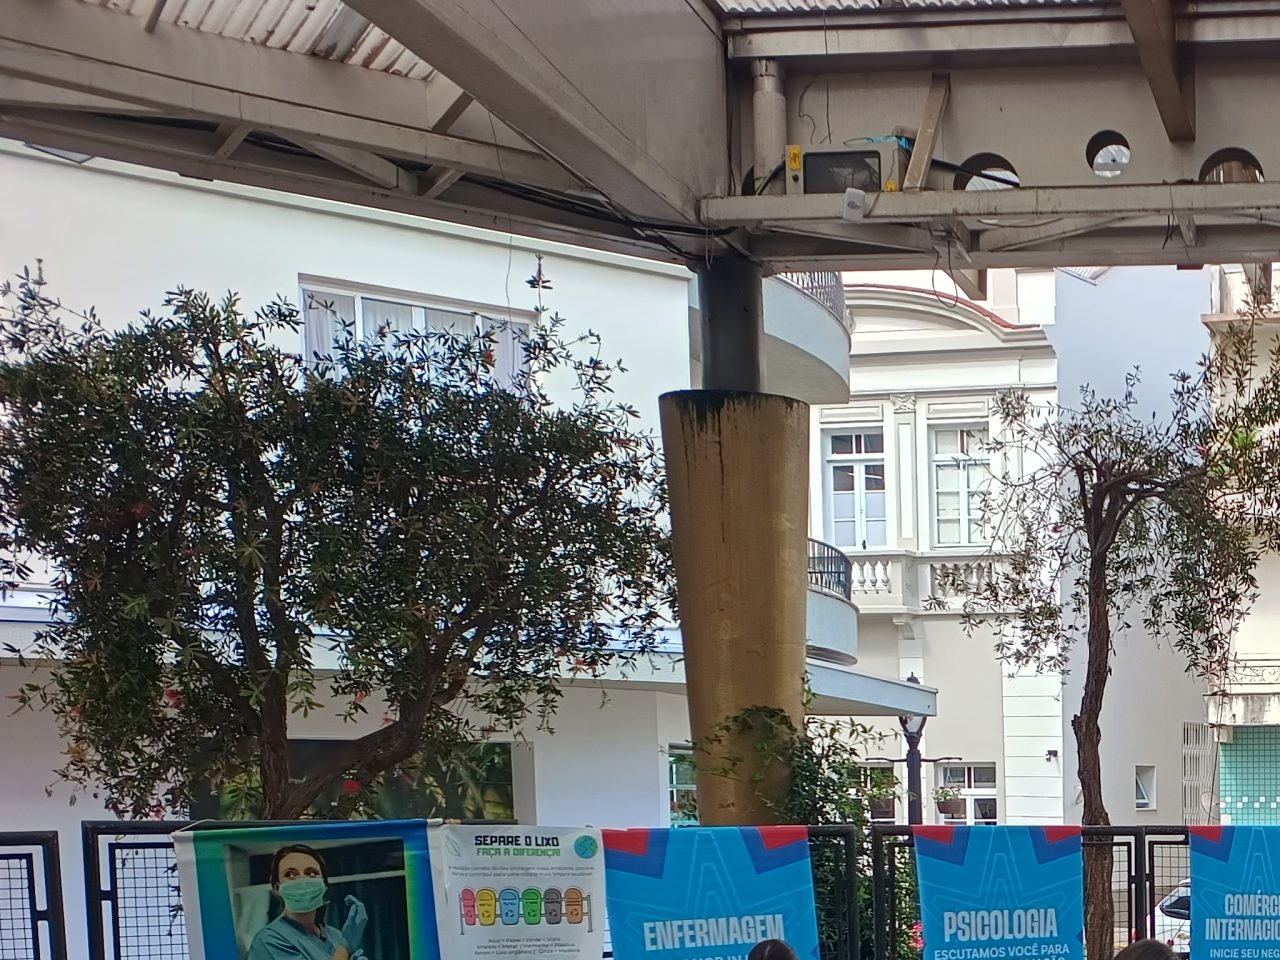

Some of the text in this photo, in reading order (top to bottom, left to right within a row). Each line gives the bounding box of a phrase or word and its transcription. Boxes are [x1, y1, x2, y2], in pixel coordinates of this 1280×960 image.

[475, 835, 559, 847] SEPARE O LIXO
[476, 848, 561, 859] FAÇA A DIFERENÇA!
[643, 914, 785, 950] ENFERMAGEM
[943, 908, 1058, 942] PSICOLOGIA
[934, 943, 1070, 960] ESCUTAMOS VOCÊ PARA
[1210, 949, 1239, 959] INICIE
[1241, 949, 1259, 959] SEU
